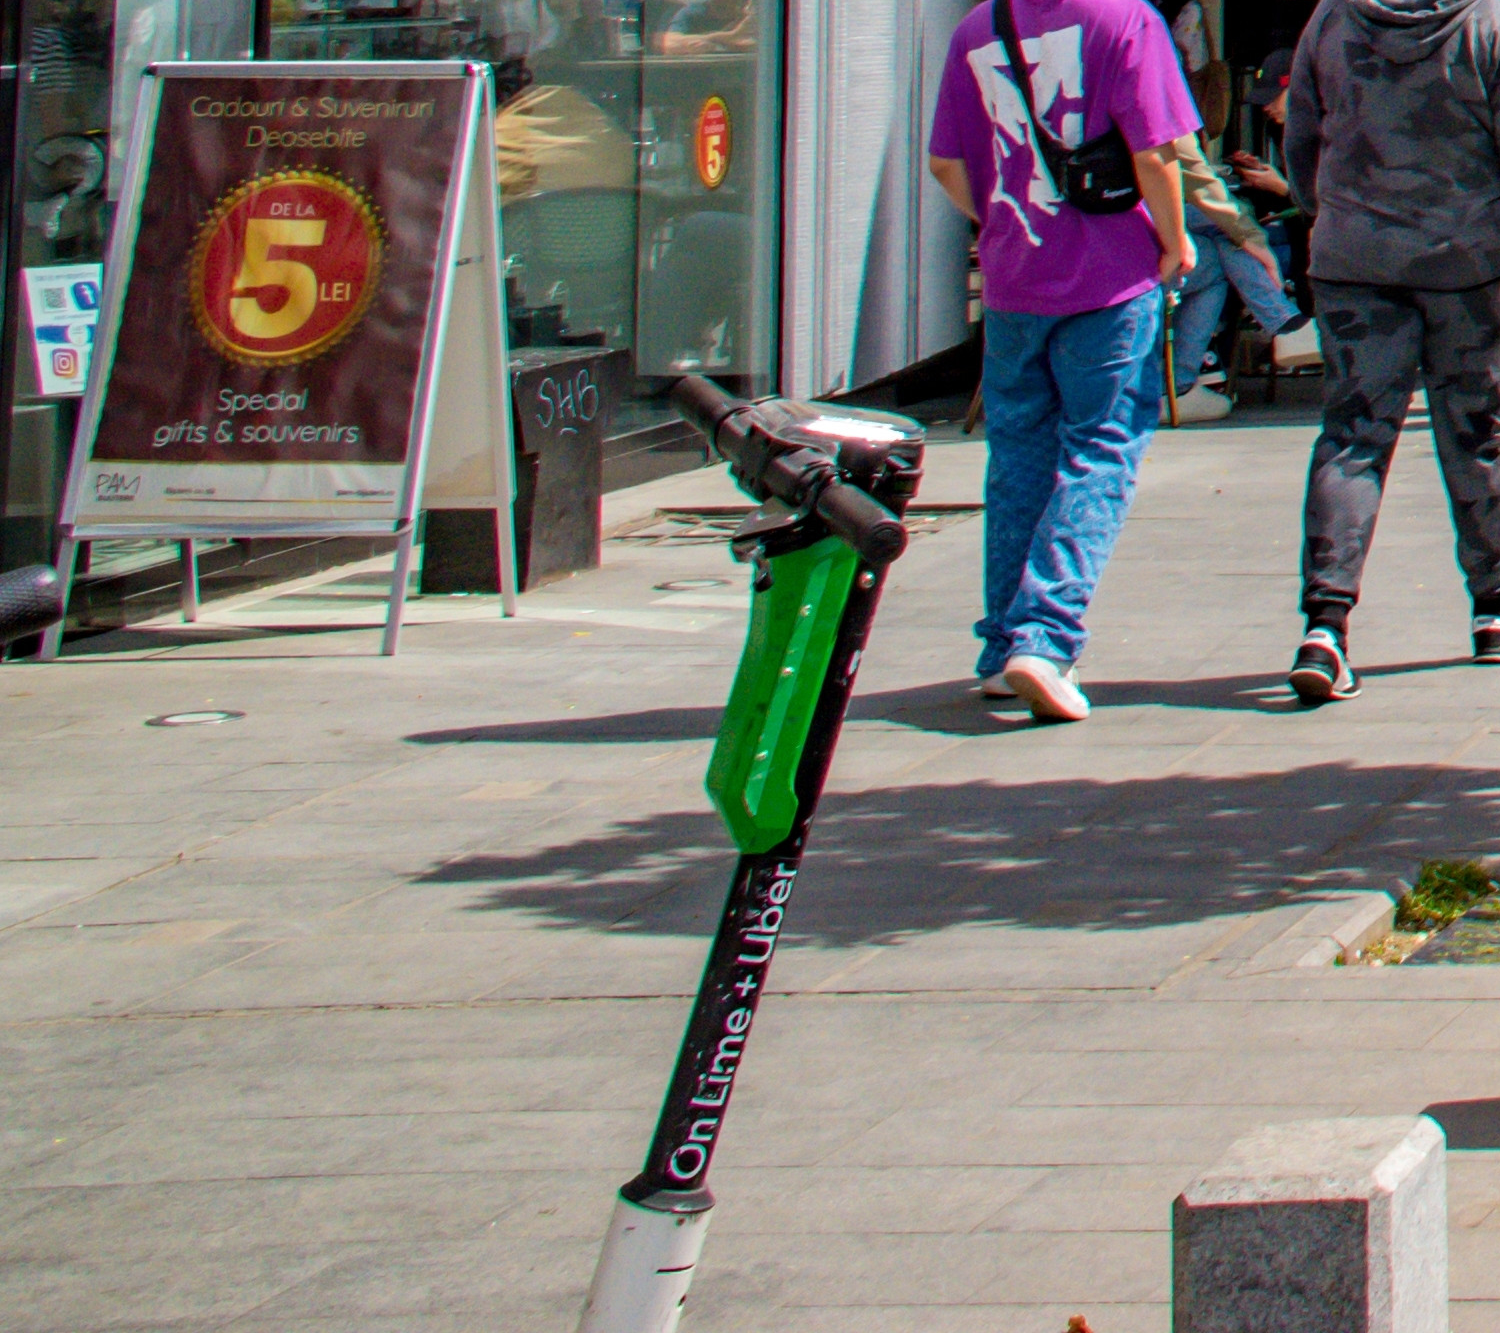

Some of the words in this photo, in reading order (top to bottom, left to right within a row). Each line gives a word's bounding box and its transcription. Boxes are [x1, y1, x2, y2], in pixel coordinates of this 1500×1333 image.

[191, 96, 286, 117] Cadouri
[291, 96, 309, 118] &
[316, 96, 435, 118] Suveniruri
[244, 125, 367, 148] Deosebite
[707, 135, 721, 179] 5
[270, 202, 293, 216] DE
[296, 203, 316, 216] LA
[230, 218, 328, 339] 5
[319, 282, 351, 302] LEI
[217, 388, 309, 415] Special
[152, 419, 208, 448] gifts
[214, 420, 233, 444] &
[241, 421, 360, 444] souvenirs
[95, 472, 141, 494] PAM
[737, 862, 797, 965] Uber
[734, 974, 758, 998] +
[690, 1007, 752, 1108] Lime
[666, 1117, 719, 1181] On
